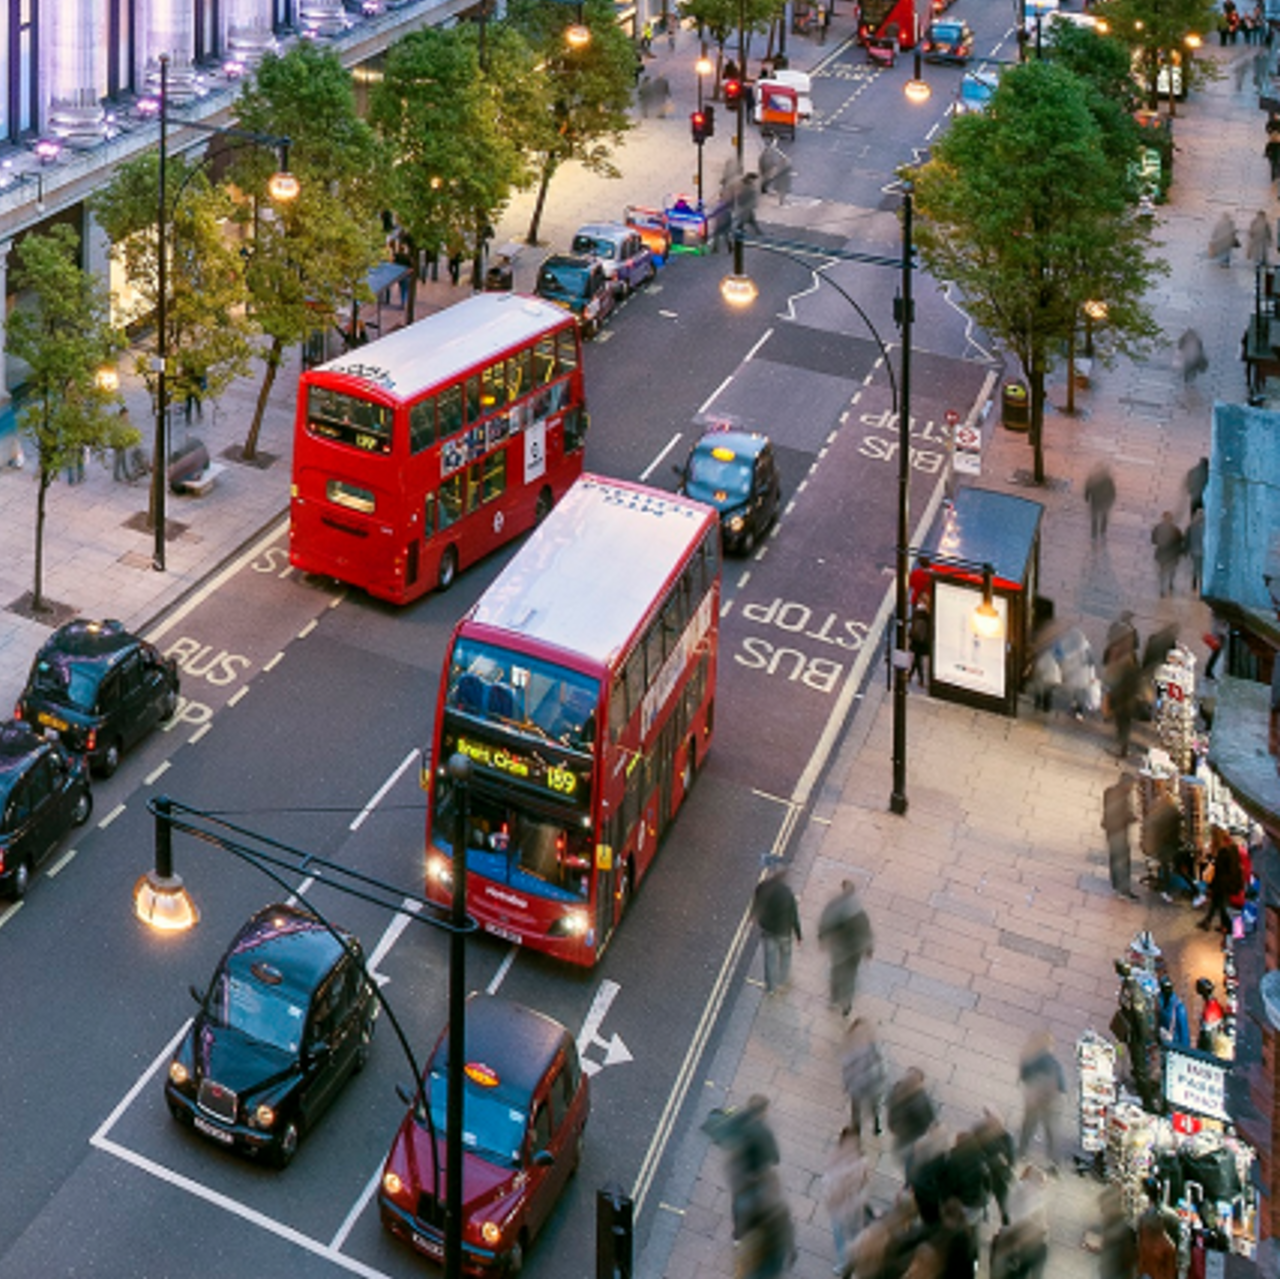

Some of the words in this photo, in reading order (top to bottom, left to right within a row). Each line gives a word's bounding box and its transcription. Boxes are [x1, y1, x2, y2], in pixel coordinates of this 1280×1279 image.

[742, 597, 870, 651] STOP
[161, 636, 252, 686] BUS
[733, 636, 844, 694] BUS
